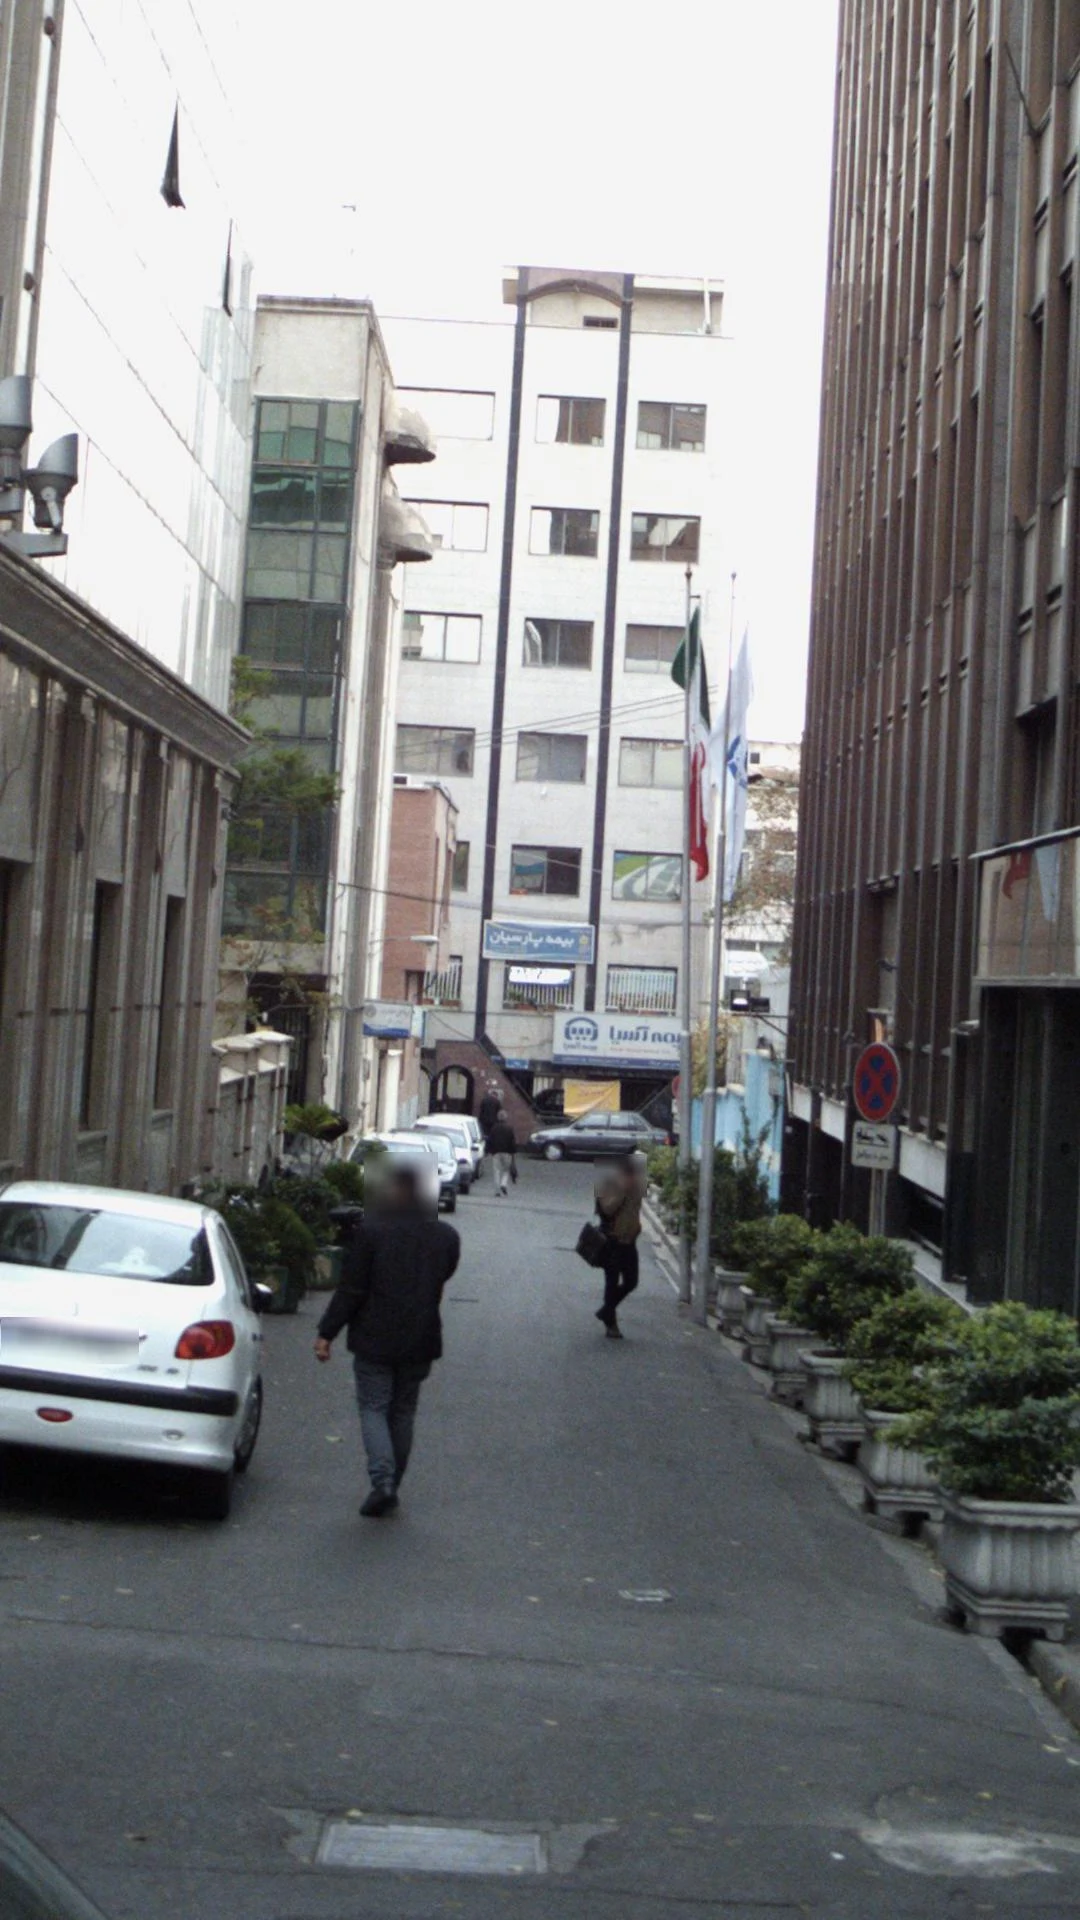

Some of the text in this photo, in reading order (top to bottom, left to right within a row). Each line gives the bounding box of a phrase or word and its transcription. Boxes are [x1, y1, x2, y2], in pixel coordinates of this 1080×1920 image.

[490, 931, 575, 949] بیمه پارسیان
[610, 1026, 681, 1049] یمه آسیا
